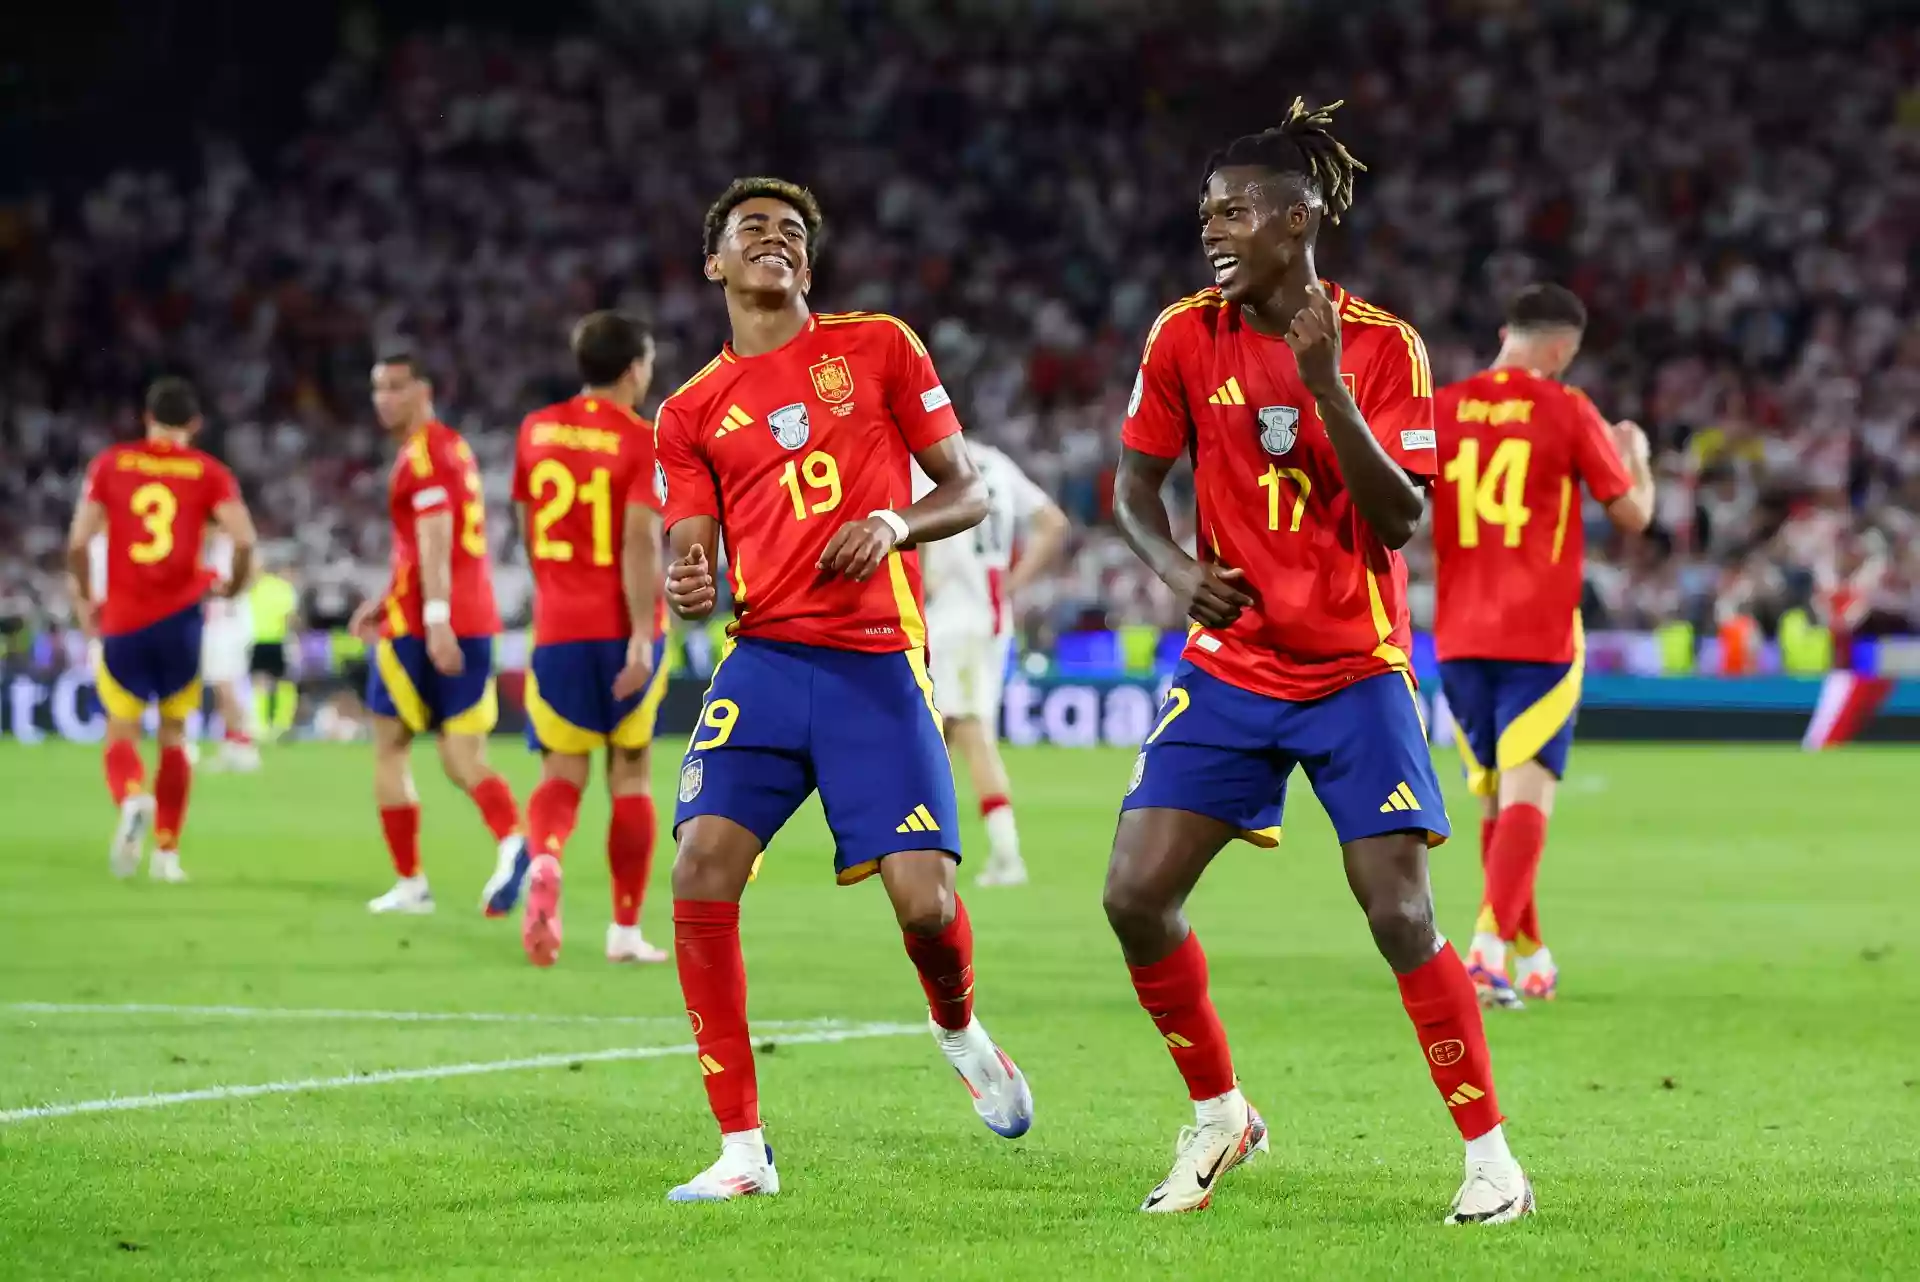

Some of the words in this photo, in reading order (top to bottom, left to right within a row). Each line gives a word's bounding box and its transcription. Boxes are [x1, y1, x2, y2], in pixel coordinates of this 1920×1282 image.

[129, 482, 177, 564] 3
[530, 458, 613, 566] 21
[779, 450, 842, 521] 19
[1258, 463, 1311, 532] 17
[1444, 437, 1531, 548] 14
